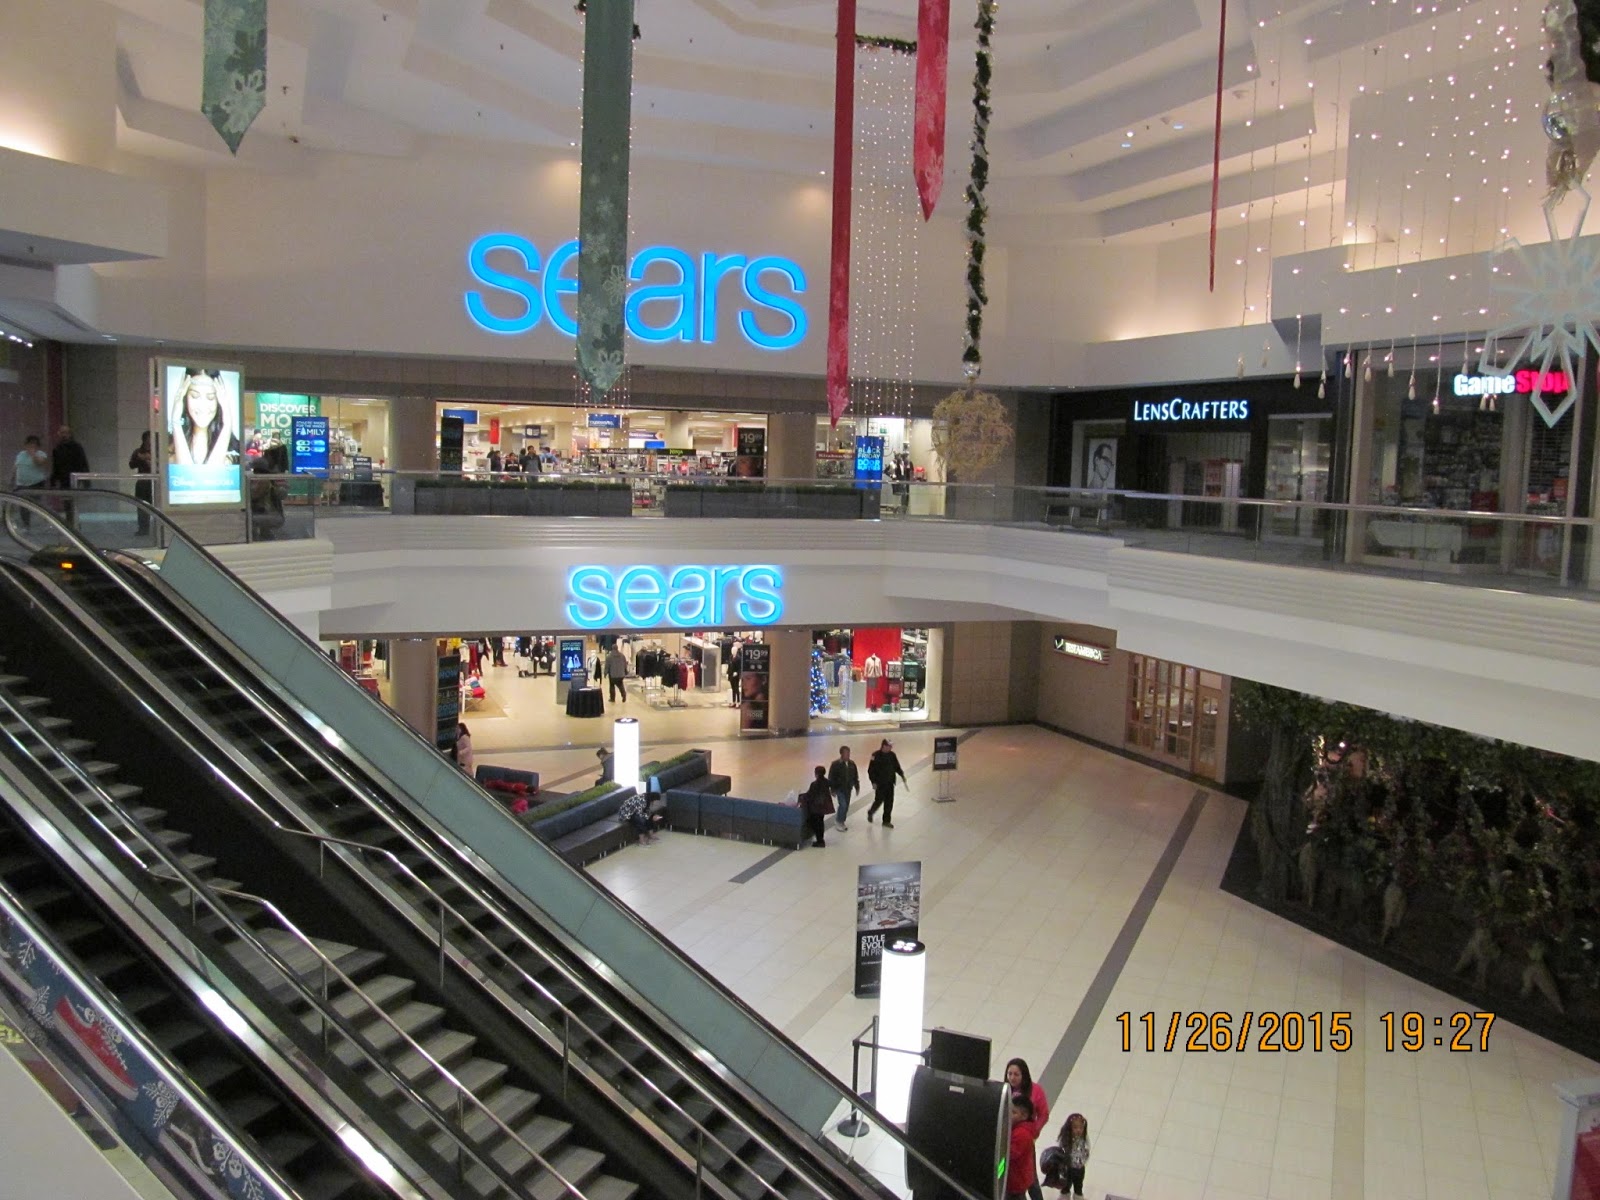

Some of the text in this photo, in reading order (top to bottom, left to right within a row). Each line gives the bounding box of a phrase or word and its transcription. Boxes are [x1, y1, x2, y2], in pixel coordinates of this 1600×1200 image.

[260, 403, 317, 414] DISCOVER
[261, 413, 300, 428] MO
[857, 458, 881, 466] DOOR
[567, 566, 784, 627] sears
[861, 934, 886, 943] STYLE
[861, 949, 870, 957] IN
